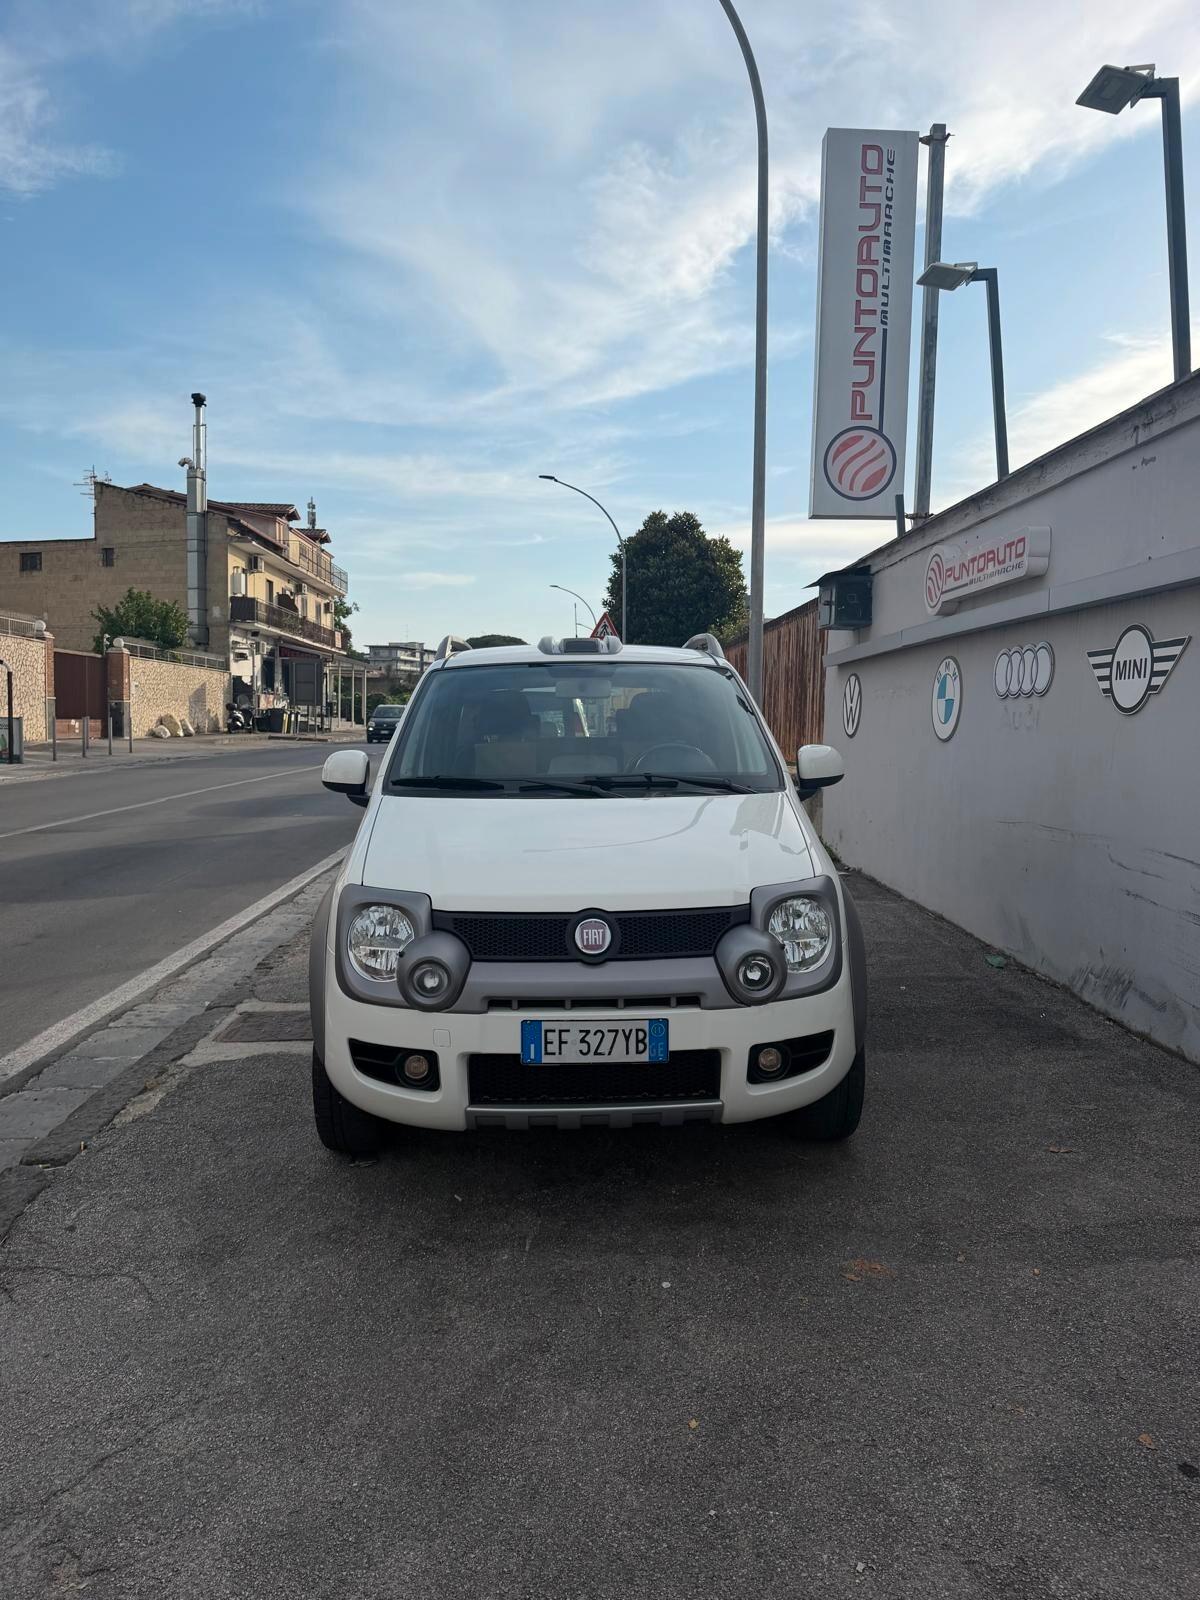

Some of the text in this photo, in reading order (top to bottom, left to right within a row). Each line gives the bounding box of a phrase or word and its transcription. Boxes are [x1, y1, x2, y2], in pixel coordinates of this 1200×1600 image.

[880, 148, 896, 326] MULTIMARCHE
[851, 144, 884, 420] PUNTOAUTO
[944, 536, 1026, 585] PUNTOAUTO
[1115, 658, 1148, 681] MINI
[583, 929, 604, 945] FIAT
[544, 1028, 648, 1056] EF 327YB
